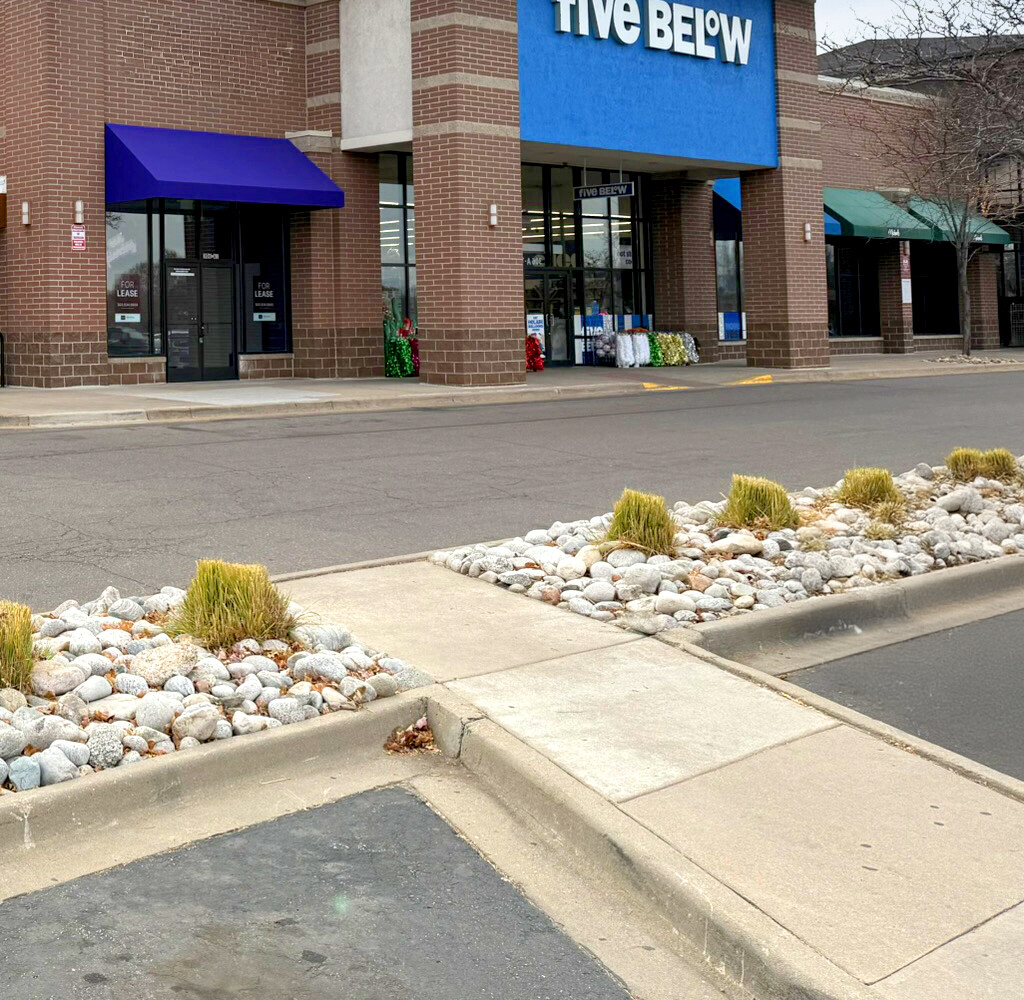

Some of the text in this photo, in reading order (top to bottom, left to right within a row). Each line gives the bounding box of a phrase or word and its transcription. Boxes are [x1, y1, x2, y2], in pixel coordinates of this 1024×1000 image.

[579, 185, 628, 198] five BELOW
[120, 280, 135, 289] FOR
[257, 282, 271, 290] FOR
[116, 289, 139, 298] LEASE
[254, 290, 275, 298] LEASE
